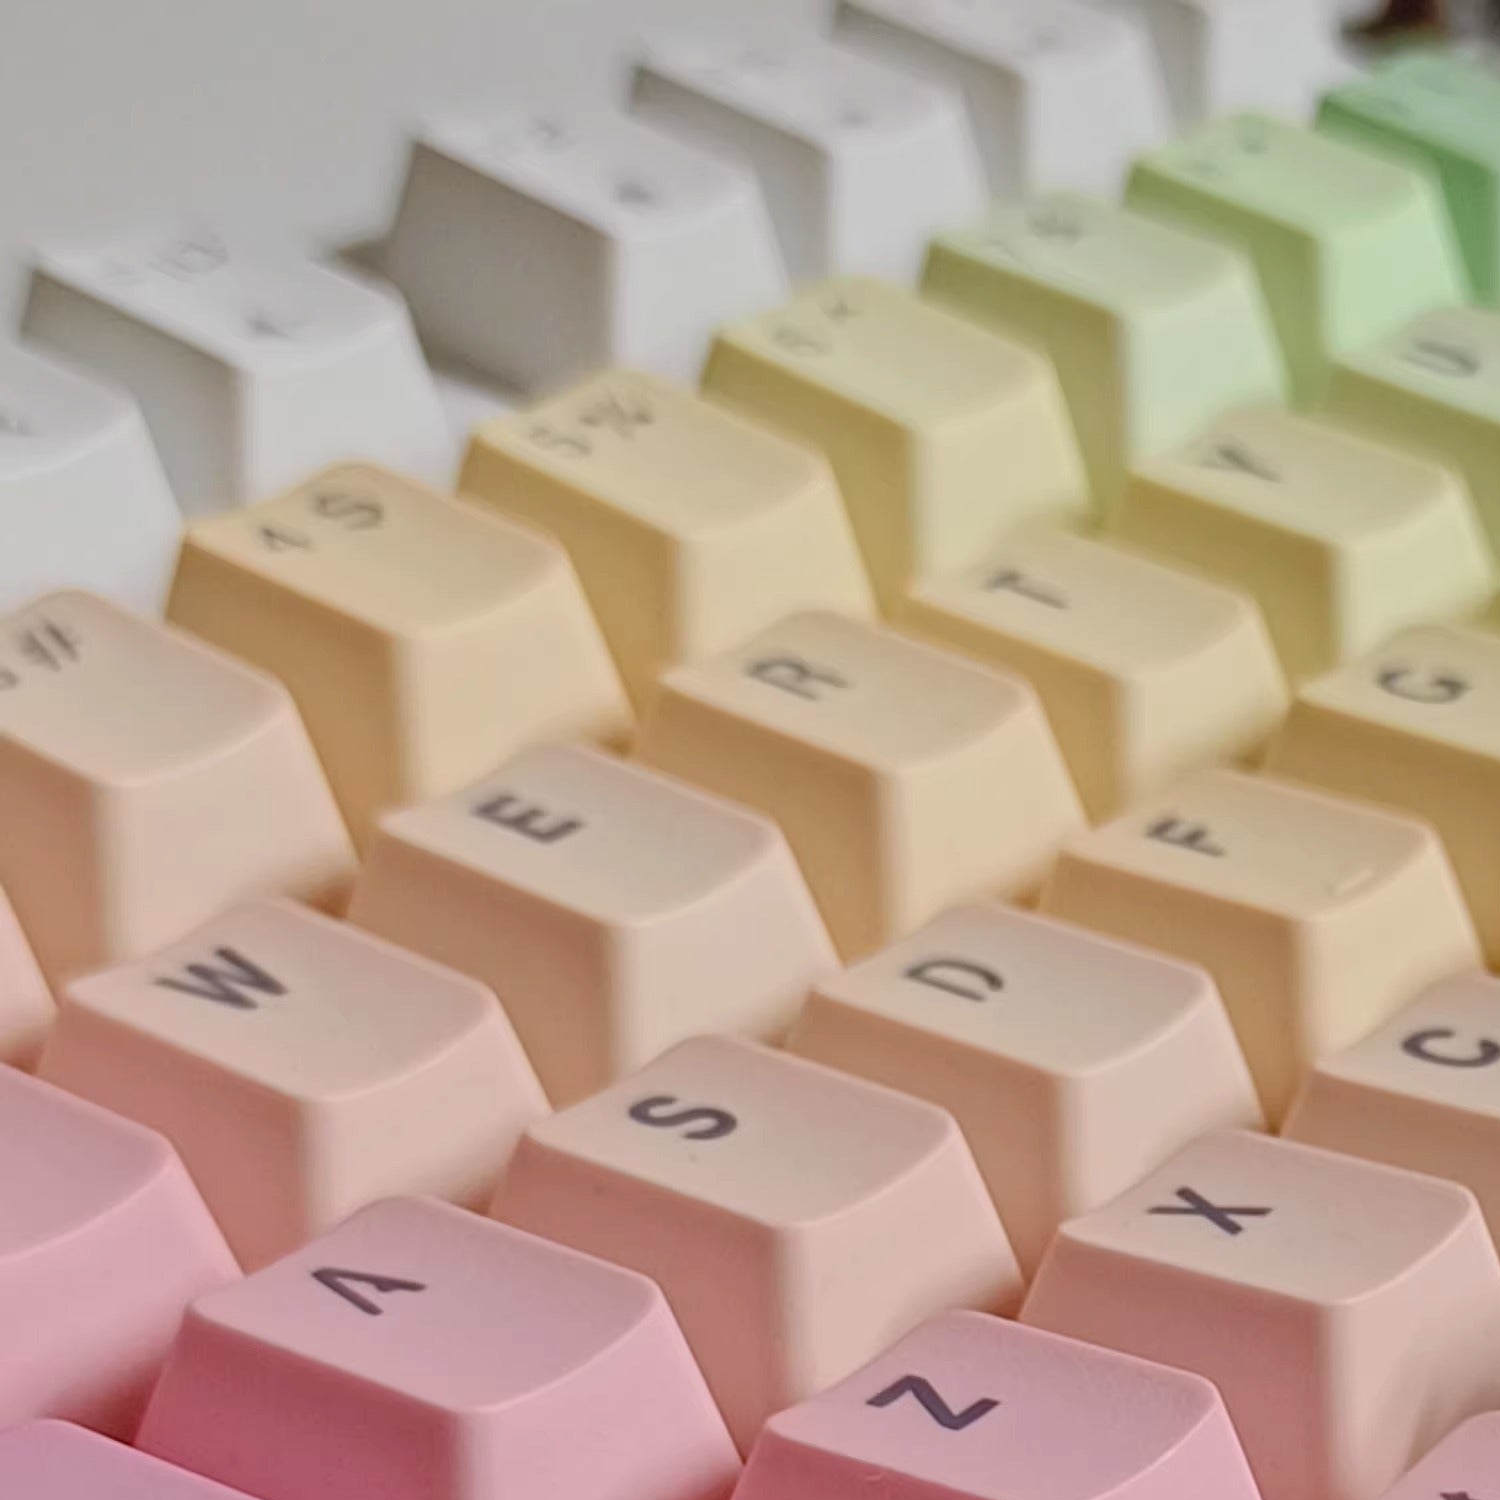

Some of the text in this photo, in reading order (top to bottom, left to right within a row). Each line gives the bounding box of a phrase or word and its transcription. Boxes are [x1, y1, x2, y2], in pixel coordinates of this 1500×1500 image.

[980, 568, 1069, 610] T
[743, 656, 850, 702] R
[1375, 667, 1470, 703] G
[469, 794, 586, 844] E
[1143, 816, 1226, 858] F
[153, 946, 289, 1010] W
[903, 957, 1006, 1003] D
[628, 1096, 737, 1140] S
[1146, 1186, 1273, 1236] X
[310, 1266, 427, 1317] A
[866, 1375, 999, 1431] Z
